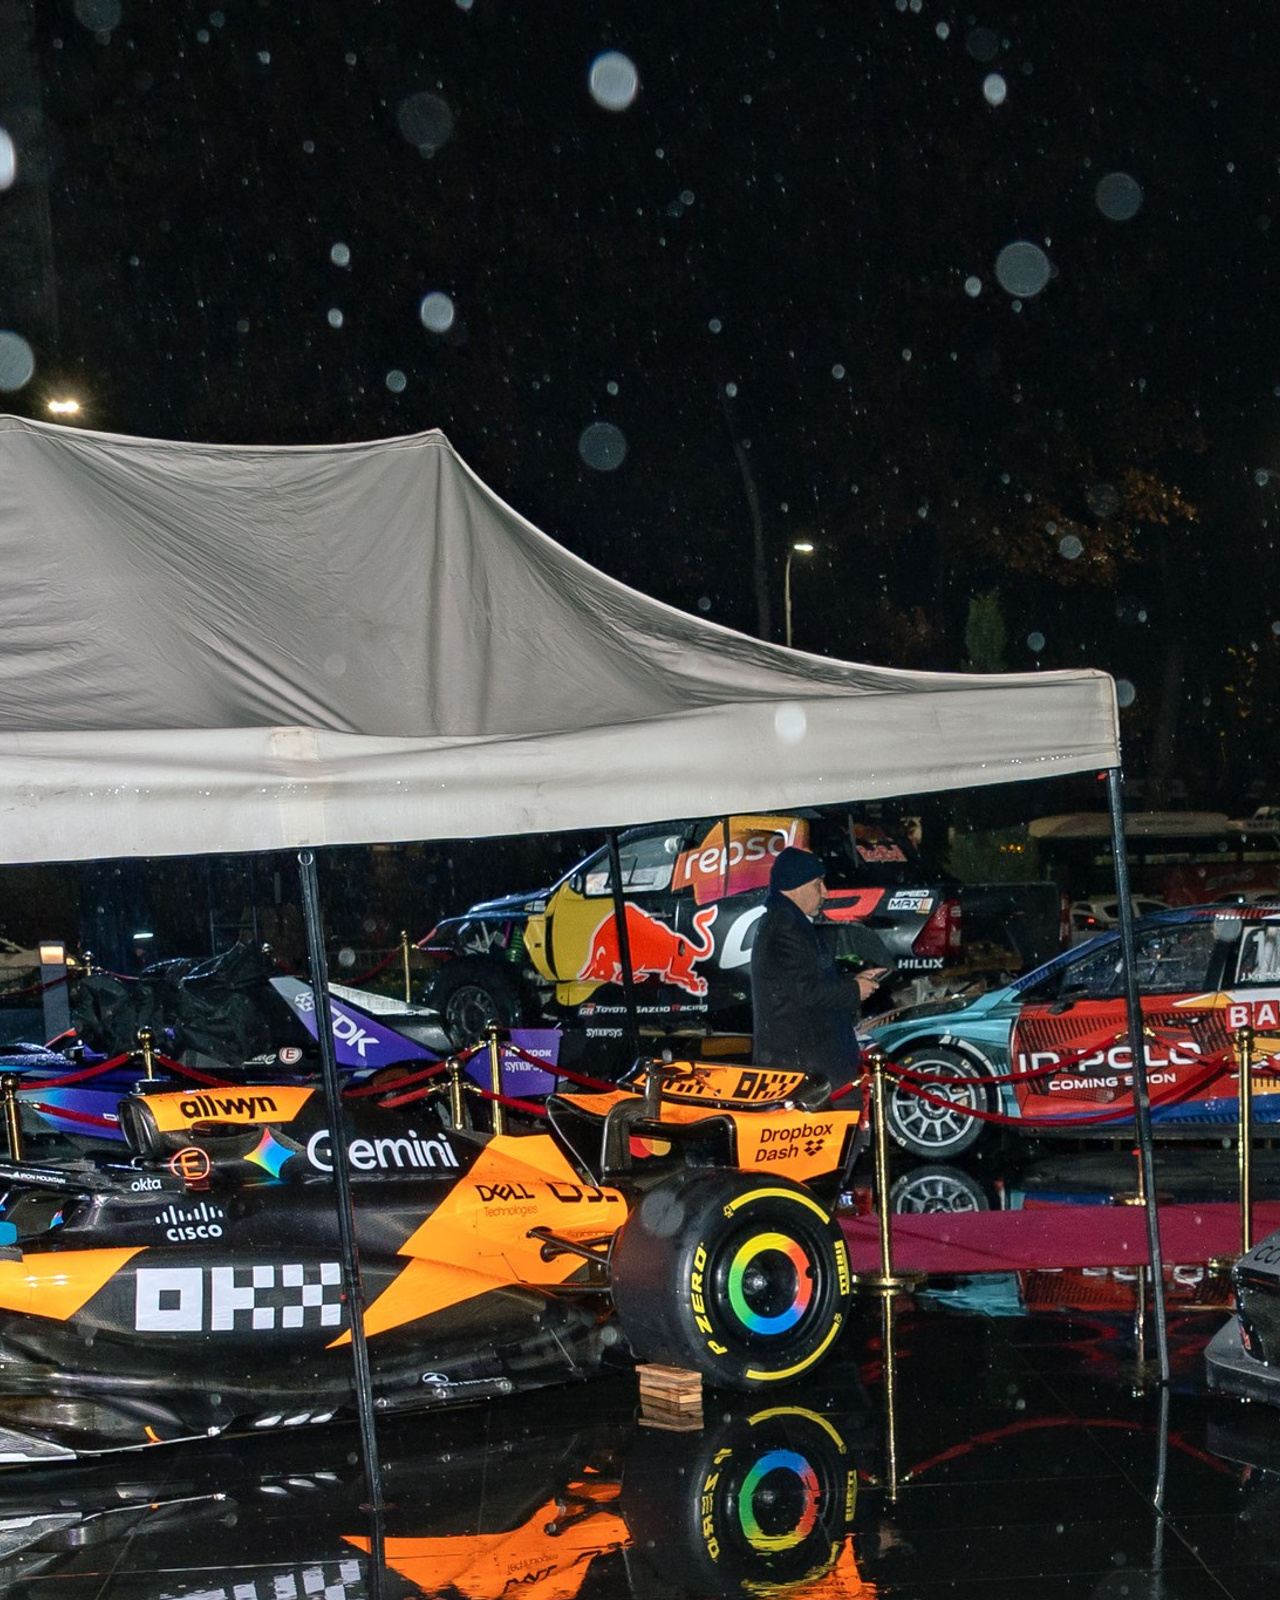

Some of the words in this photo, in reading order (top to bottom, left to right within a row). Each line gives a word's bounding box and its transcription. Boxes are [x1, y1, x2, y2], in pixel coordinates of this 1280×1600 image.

[684, 820, 798, 880] repsol
[898, 957, 943, 969] HILUX
[595, 1005, 627, 1014] TOYOT
[1048, 1076, 1119, 1091] COMING
[1125, 1073, 1177, 1086] SON
[180, 1094, 278, 1119] allwyn
[760, 1122, 834, 1143] Dropbox
[307, 1129, 460, 1172] Gemini
[755, 1145, 799, 1163] Dash
[131, 1178, 162, 1192] okta
[475, 1183, 536, 1202] DELL
[484, 1203, 539, 1218] Technologies
[167, 1224, 223, 1242] cisco
[135, 1261, 341, 1332] OKX
[691, 1245, 714, 1335] ZERO
